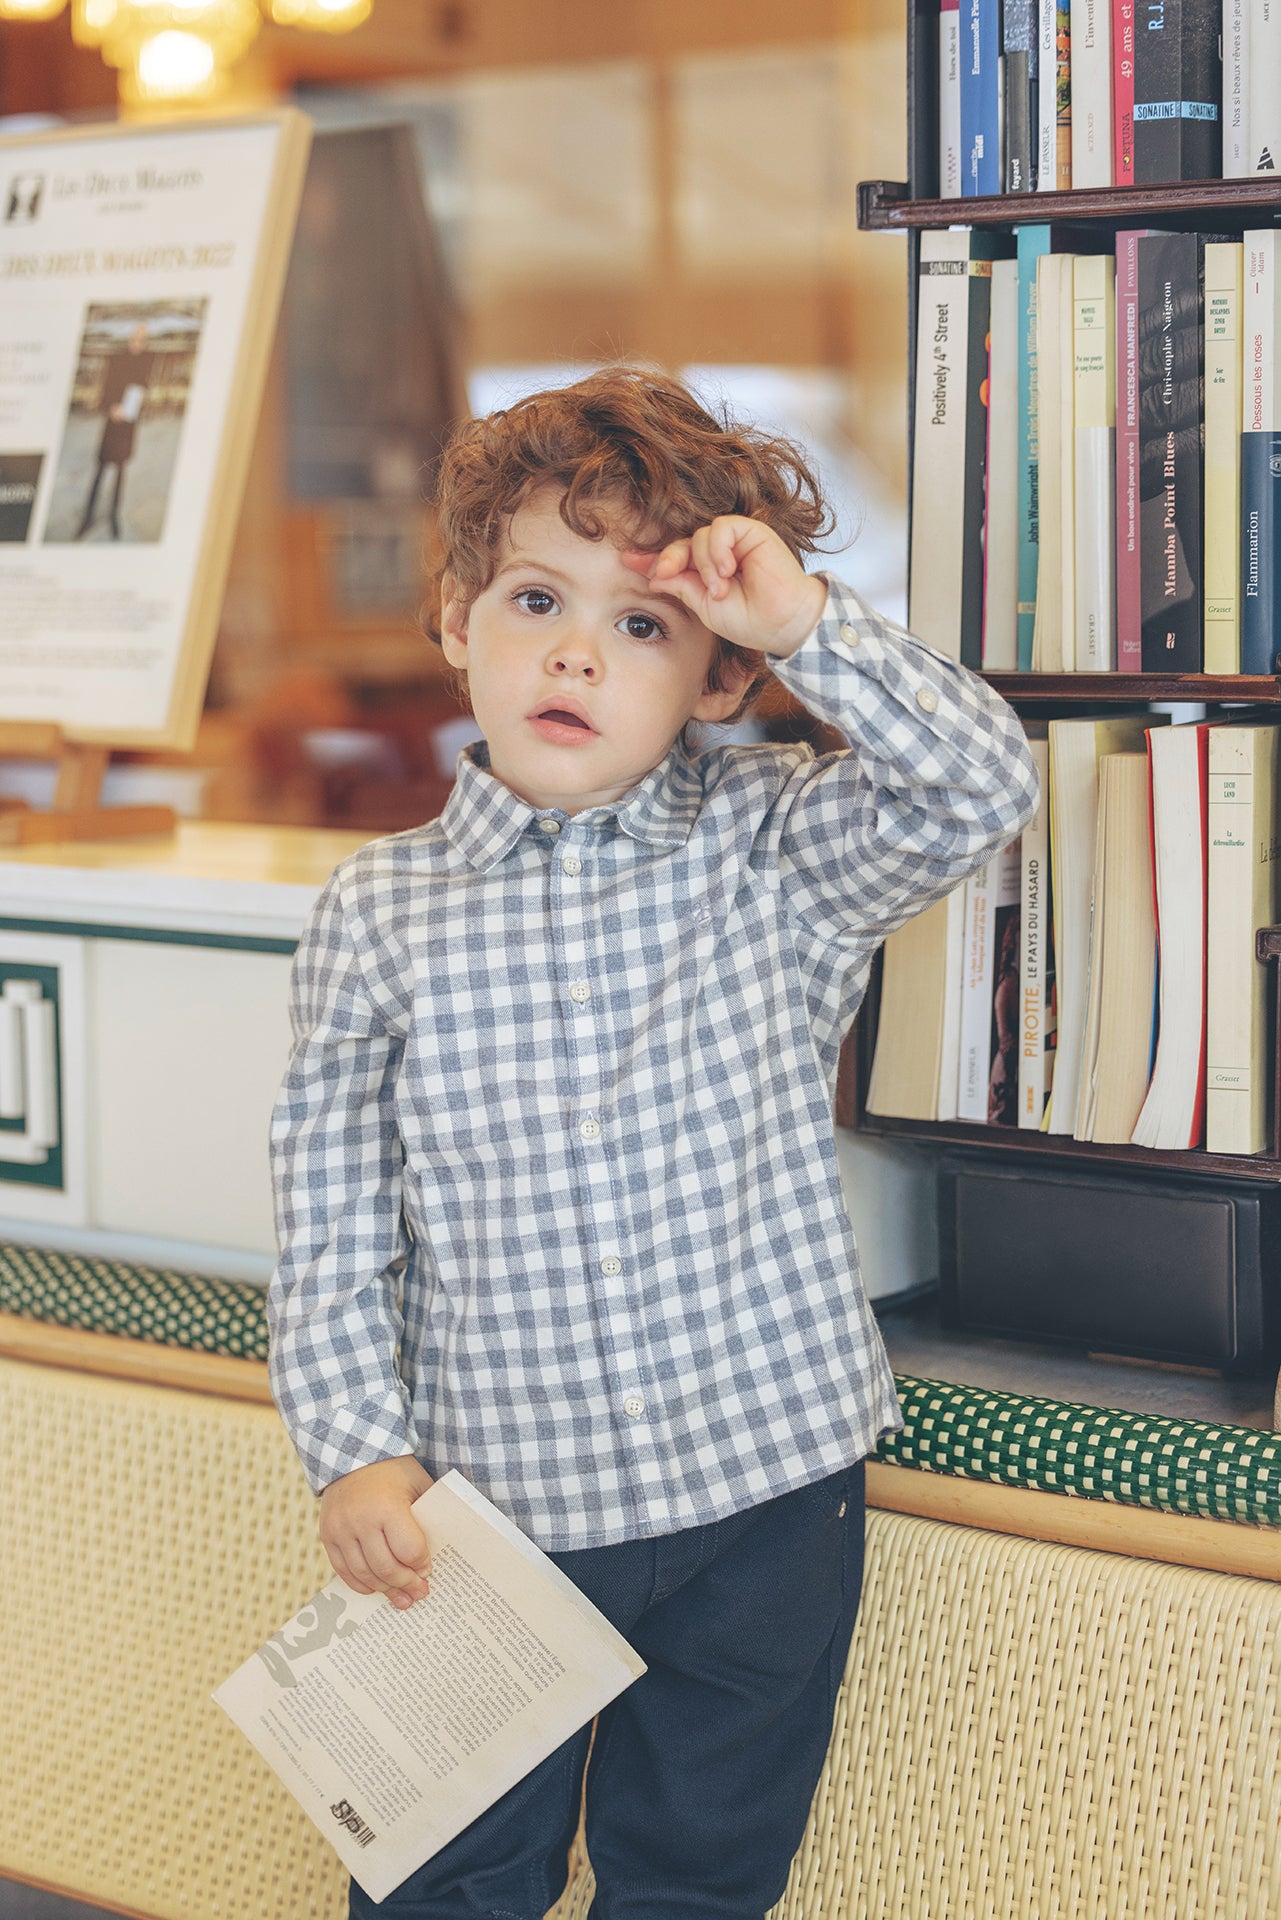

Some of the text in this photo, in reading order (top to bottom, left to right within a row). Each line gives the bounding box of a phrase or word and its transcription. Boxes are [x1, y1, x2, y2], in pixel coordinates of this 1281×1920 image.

[1043, 33, 1051, 50] Ces
[1121, 4, 1133, 79] 49 ans et
[1231, 20, 1241, 33] de
[948, 26, 957, 81] Hors de toi
[972, 18, 981, 75] Emmanuelle
[1231, 34, 1241, 62] rêves
[1231, 64, 1241, 94] beaux
[1137, 103, 1175, 119] SONATINE
[1188, 103, 1215, 120] SONATINE
[1232, 94, 1241, 104] si
[1232, 106, 1241, 128] Nos
[1042, 125, 1050, 176] LE PASSEUR
[1011, 158, 1021, 190] fayard
[1127, 237, 1135, 288] PAVILLONS
[1257, 251, 1265, 275] Adam
[935, 303, 949, 342] Street
[1163, 281, 1175, 405] Christophe Naigeon
[1127, 302, 1136, 426] FRANCESCA MANFREDI
[1252, 334, 1262, 430] Dessous les roses
[932, 365, 950, 425] Positively
[1127, 441, 1138, 552] Un bon endroit pour vivre
[1164, 431, 1176, 596] Mamba Point Blues
[1029, 521, 1038, 544] John
[1247, 511, 1259, 598] Flammarion
[1207, 604, 1232, 614] Grasset
[1023, 859, 1041, 1058] PIROTTE, LE PAYS DU HASARD
[1215, 1073, 1241, 1084] Grasset
